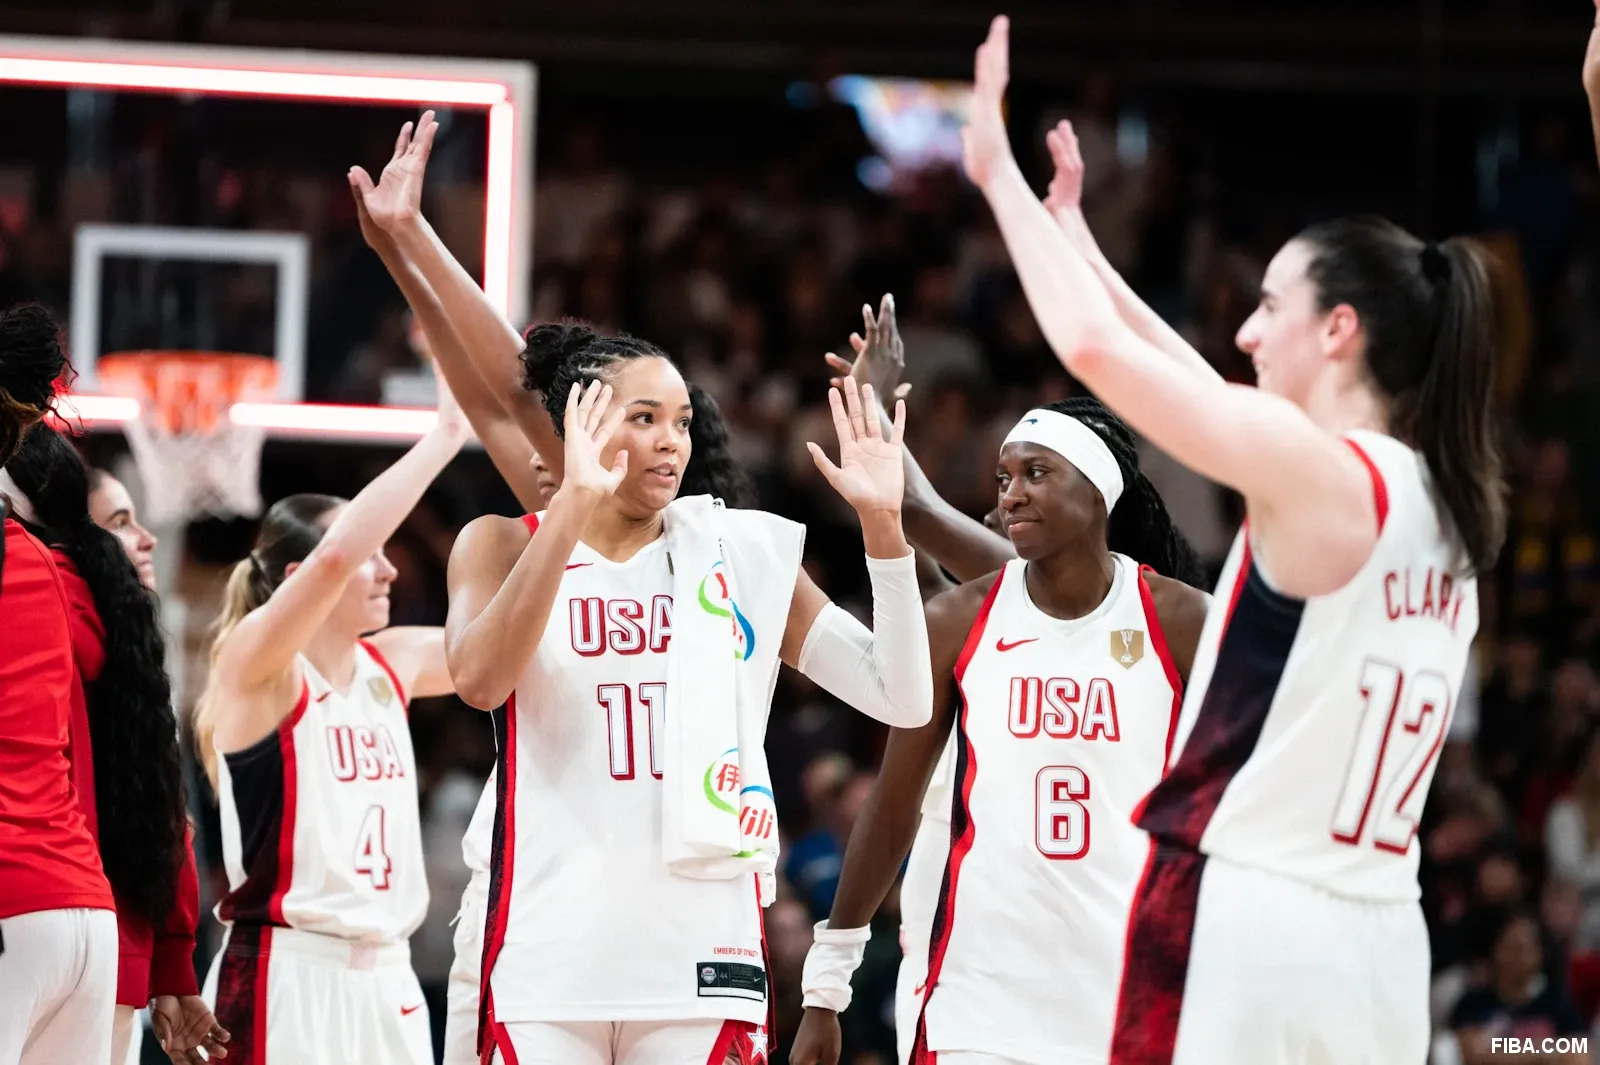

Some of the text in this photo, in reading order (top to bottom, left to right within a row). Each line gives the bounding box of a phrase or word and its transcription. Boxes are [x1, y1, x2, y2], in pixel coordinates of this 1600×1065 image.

[569, 595, 673, 657] USA
[598, 682, 667, 780] 11
[1008, 677, 1120, 742] USA
[326, 724, 404, 782] USA
[1331, 656, 1451, 856] 12
[354, 804, 392, 891] 4
[1035, 765, 1091, 860] 6
[713, 947, 736, 955] EMBERS
